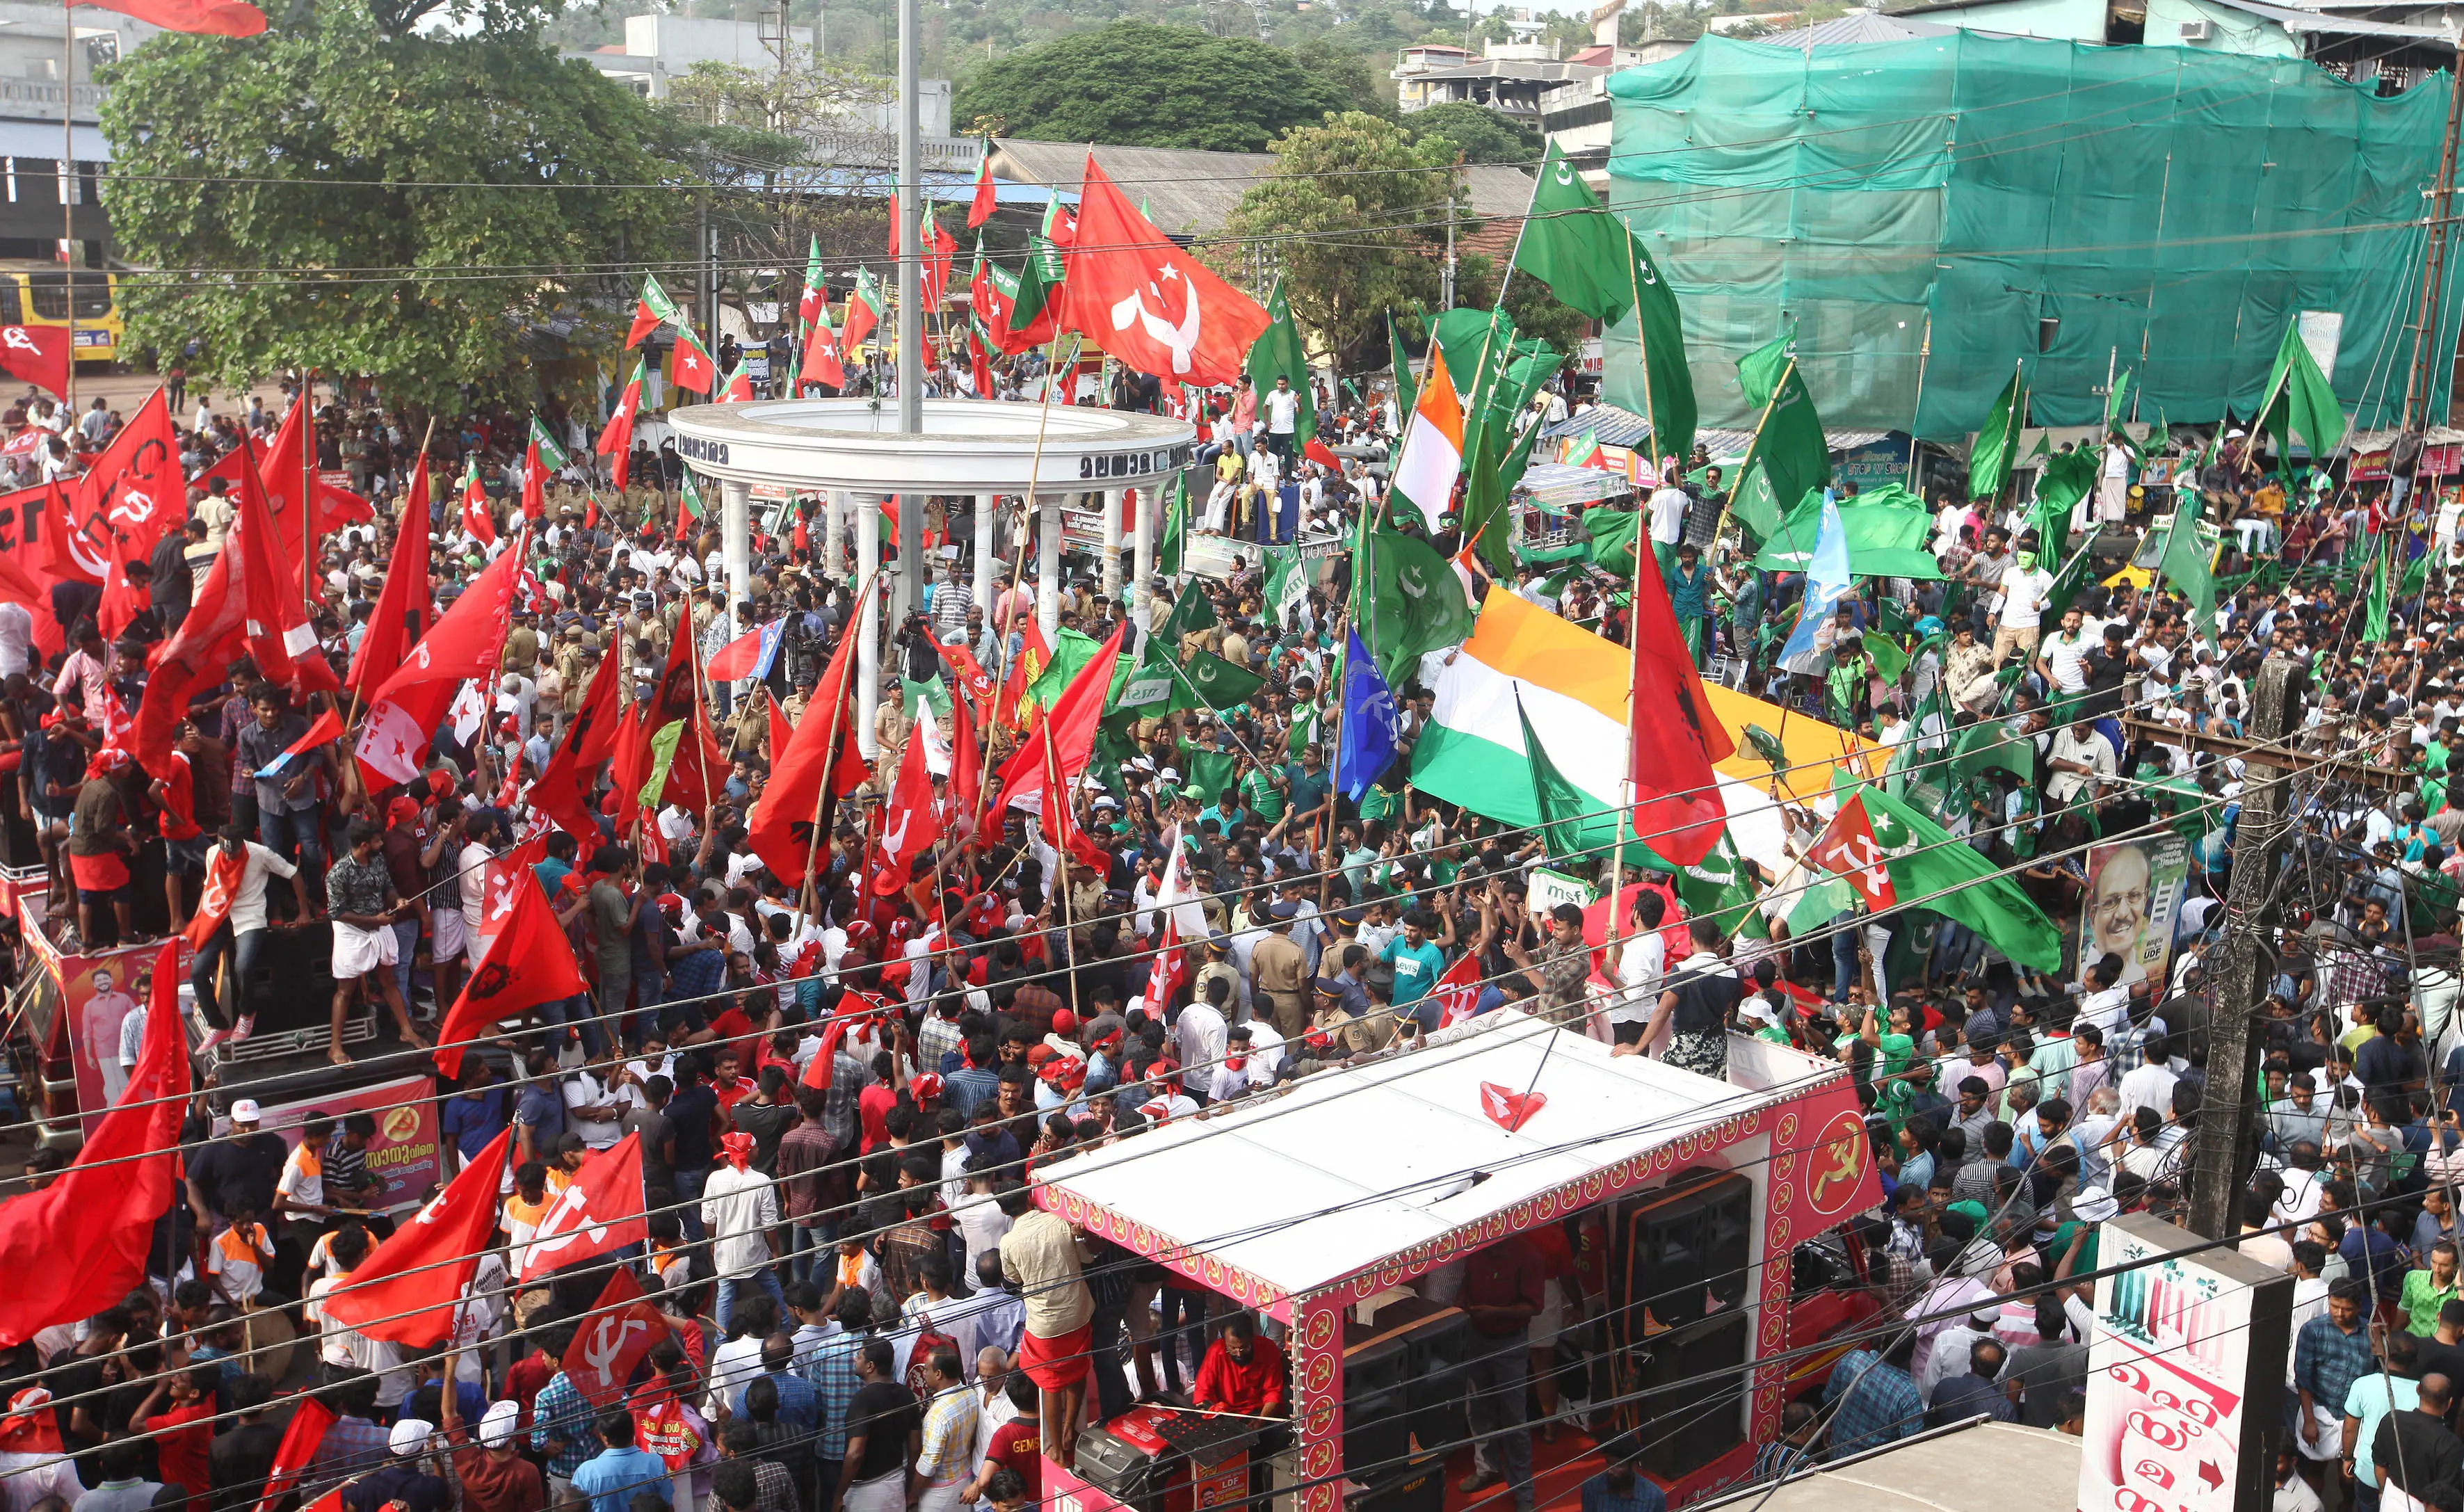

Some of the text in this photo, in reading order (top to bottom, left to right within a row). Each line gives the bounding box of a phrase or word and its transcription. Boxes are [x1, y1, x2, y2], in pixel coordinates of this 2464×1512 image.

[1848, 463, 1871, 476] STOP
[1885, 462, 1908, 475] SHOP
[362, 702, 389, 755] DYFI
[415, 828, 426, 838] 03
[1547, 884, 1581, 903] msf
[2143, 948, 2161, 959] UDF
[1154, 1465, 1174, 1478] HONDA
[1222, 1477, 1239, 1489] LDF
